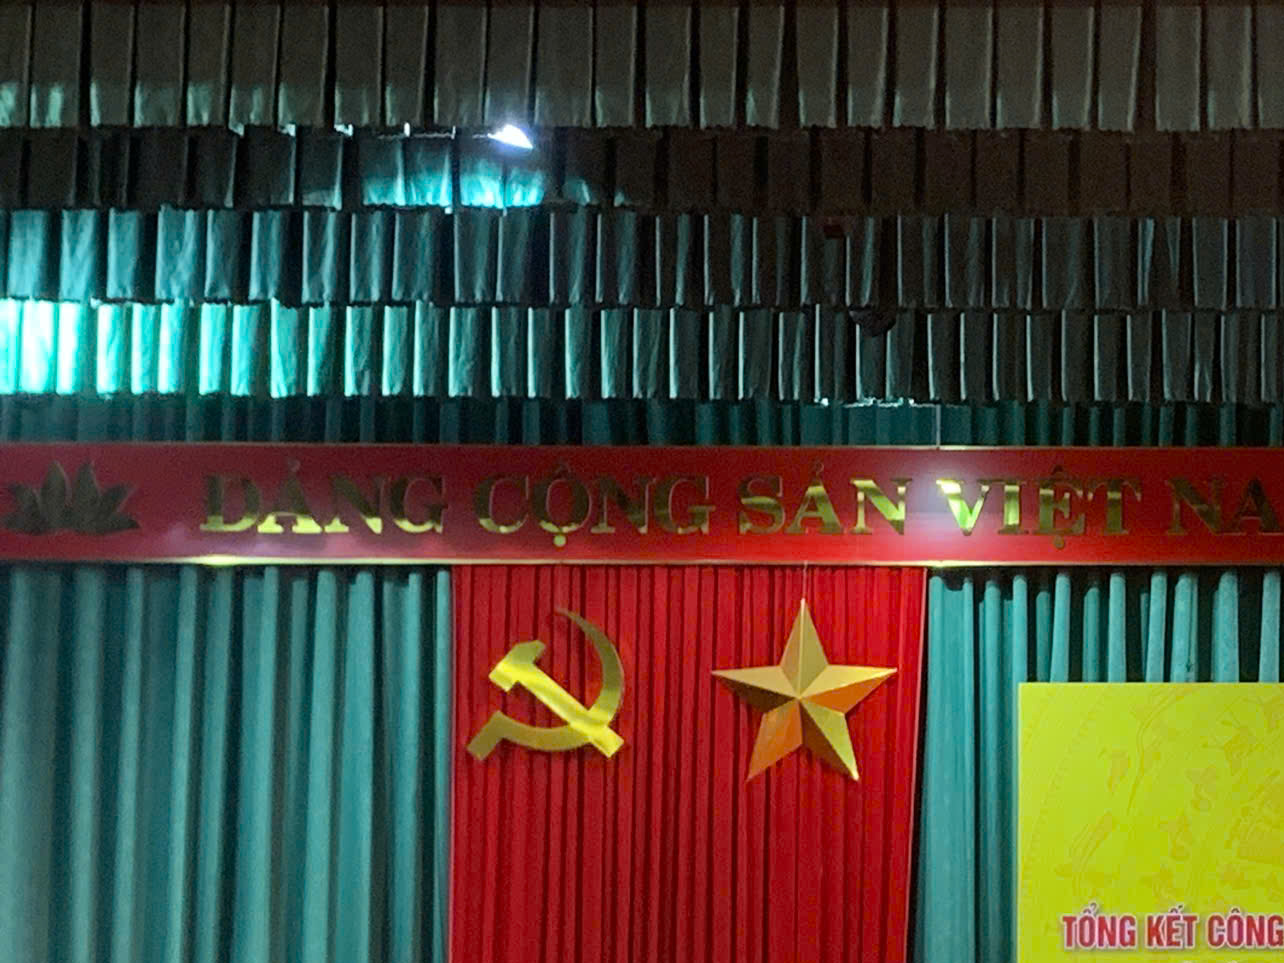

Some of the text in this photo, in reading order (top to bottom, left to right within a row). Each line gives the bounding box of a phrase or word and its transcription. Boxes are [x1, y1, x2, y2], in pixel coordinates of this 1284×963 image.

[473, 459, 716, 547] CỘNG
[737, 461, 912, 535] SẢN
[936, 465, 1142, 549] VIỆT
[1062, 903, 1136, 948] TỔNG
[1146, 905, 1198, 948] KẾT
[1207, 907, 1284, 948] CÔNG
